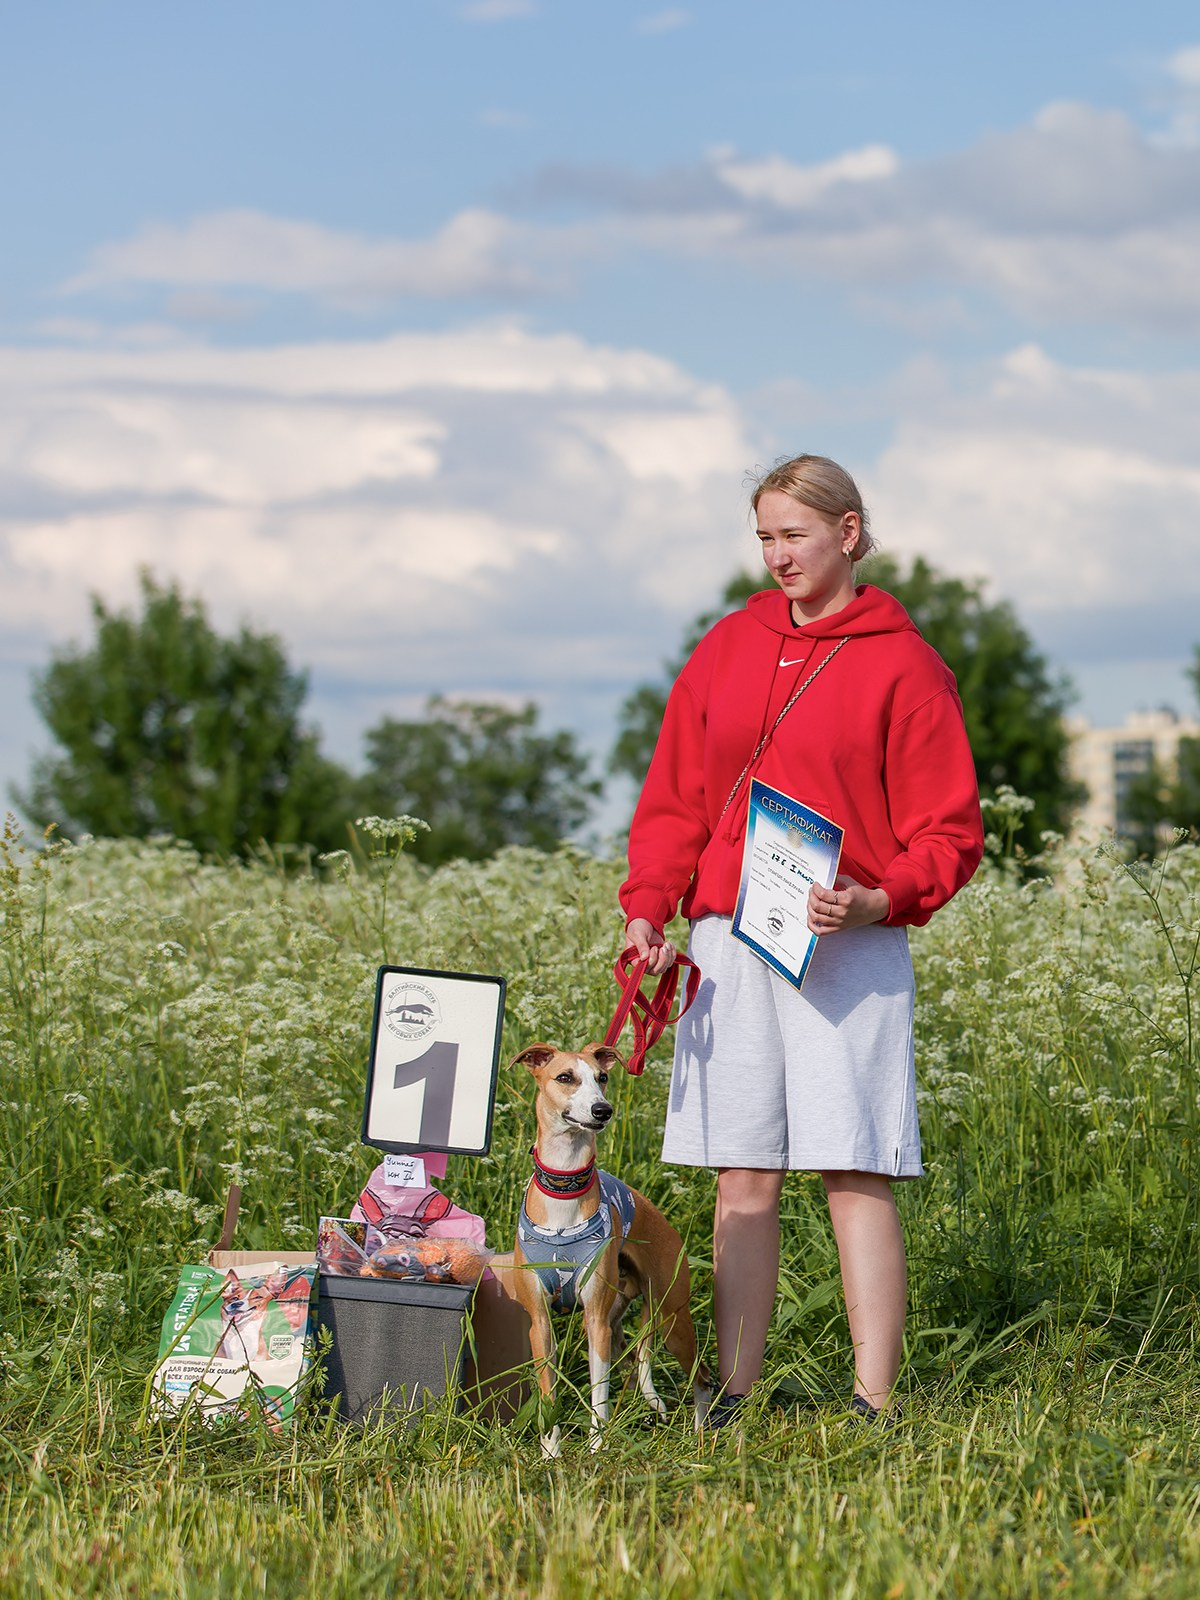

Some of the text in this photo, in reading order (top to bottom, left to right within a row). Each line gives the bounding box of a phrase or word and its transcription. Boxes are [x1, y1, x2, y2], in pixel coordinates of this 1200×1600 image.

[761, 796, 833, 845] СЕРТИФИКАТ
[388, 983, 436, 1004] БАЛТИЙСКИЙ КЛУБ
[388, 1023, 432, 1039] БЕГОВЫХ СОБАК
[393, 1041, 460, 1147] 1
